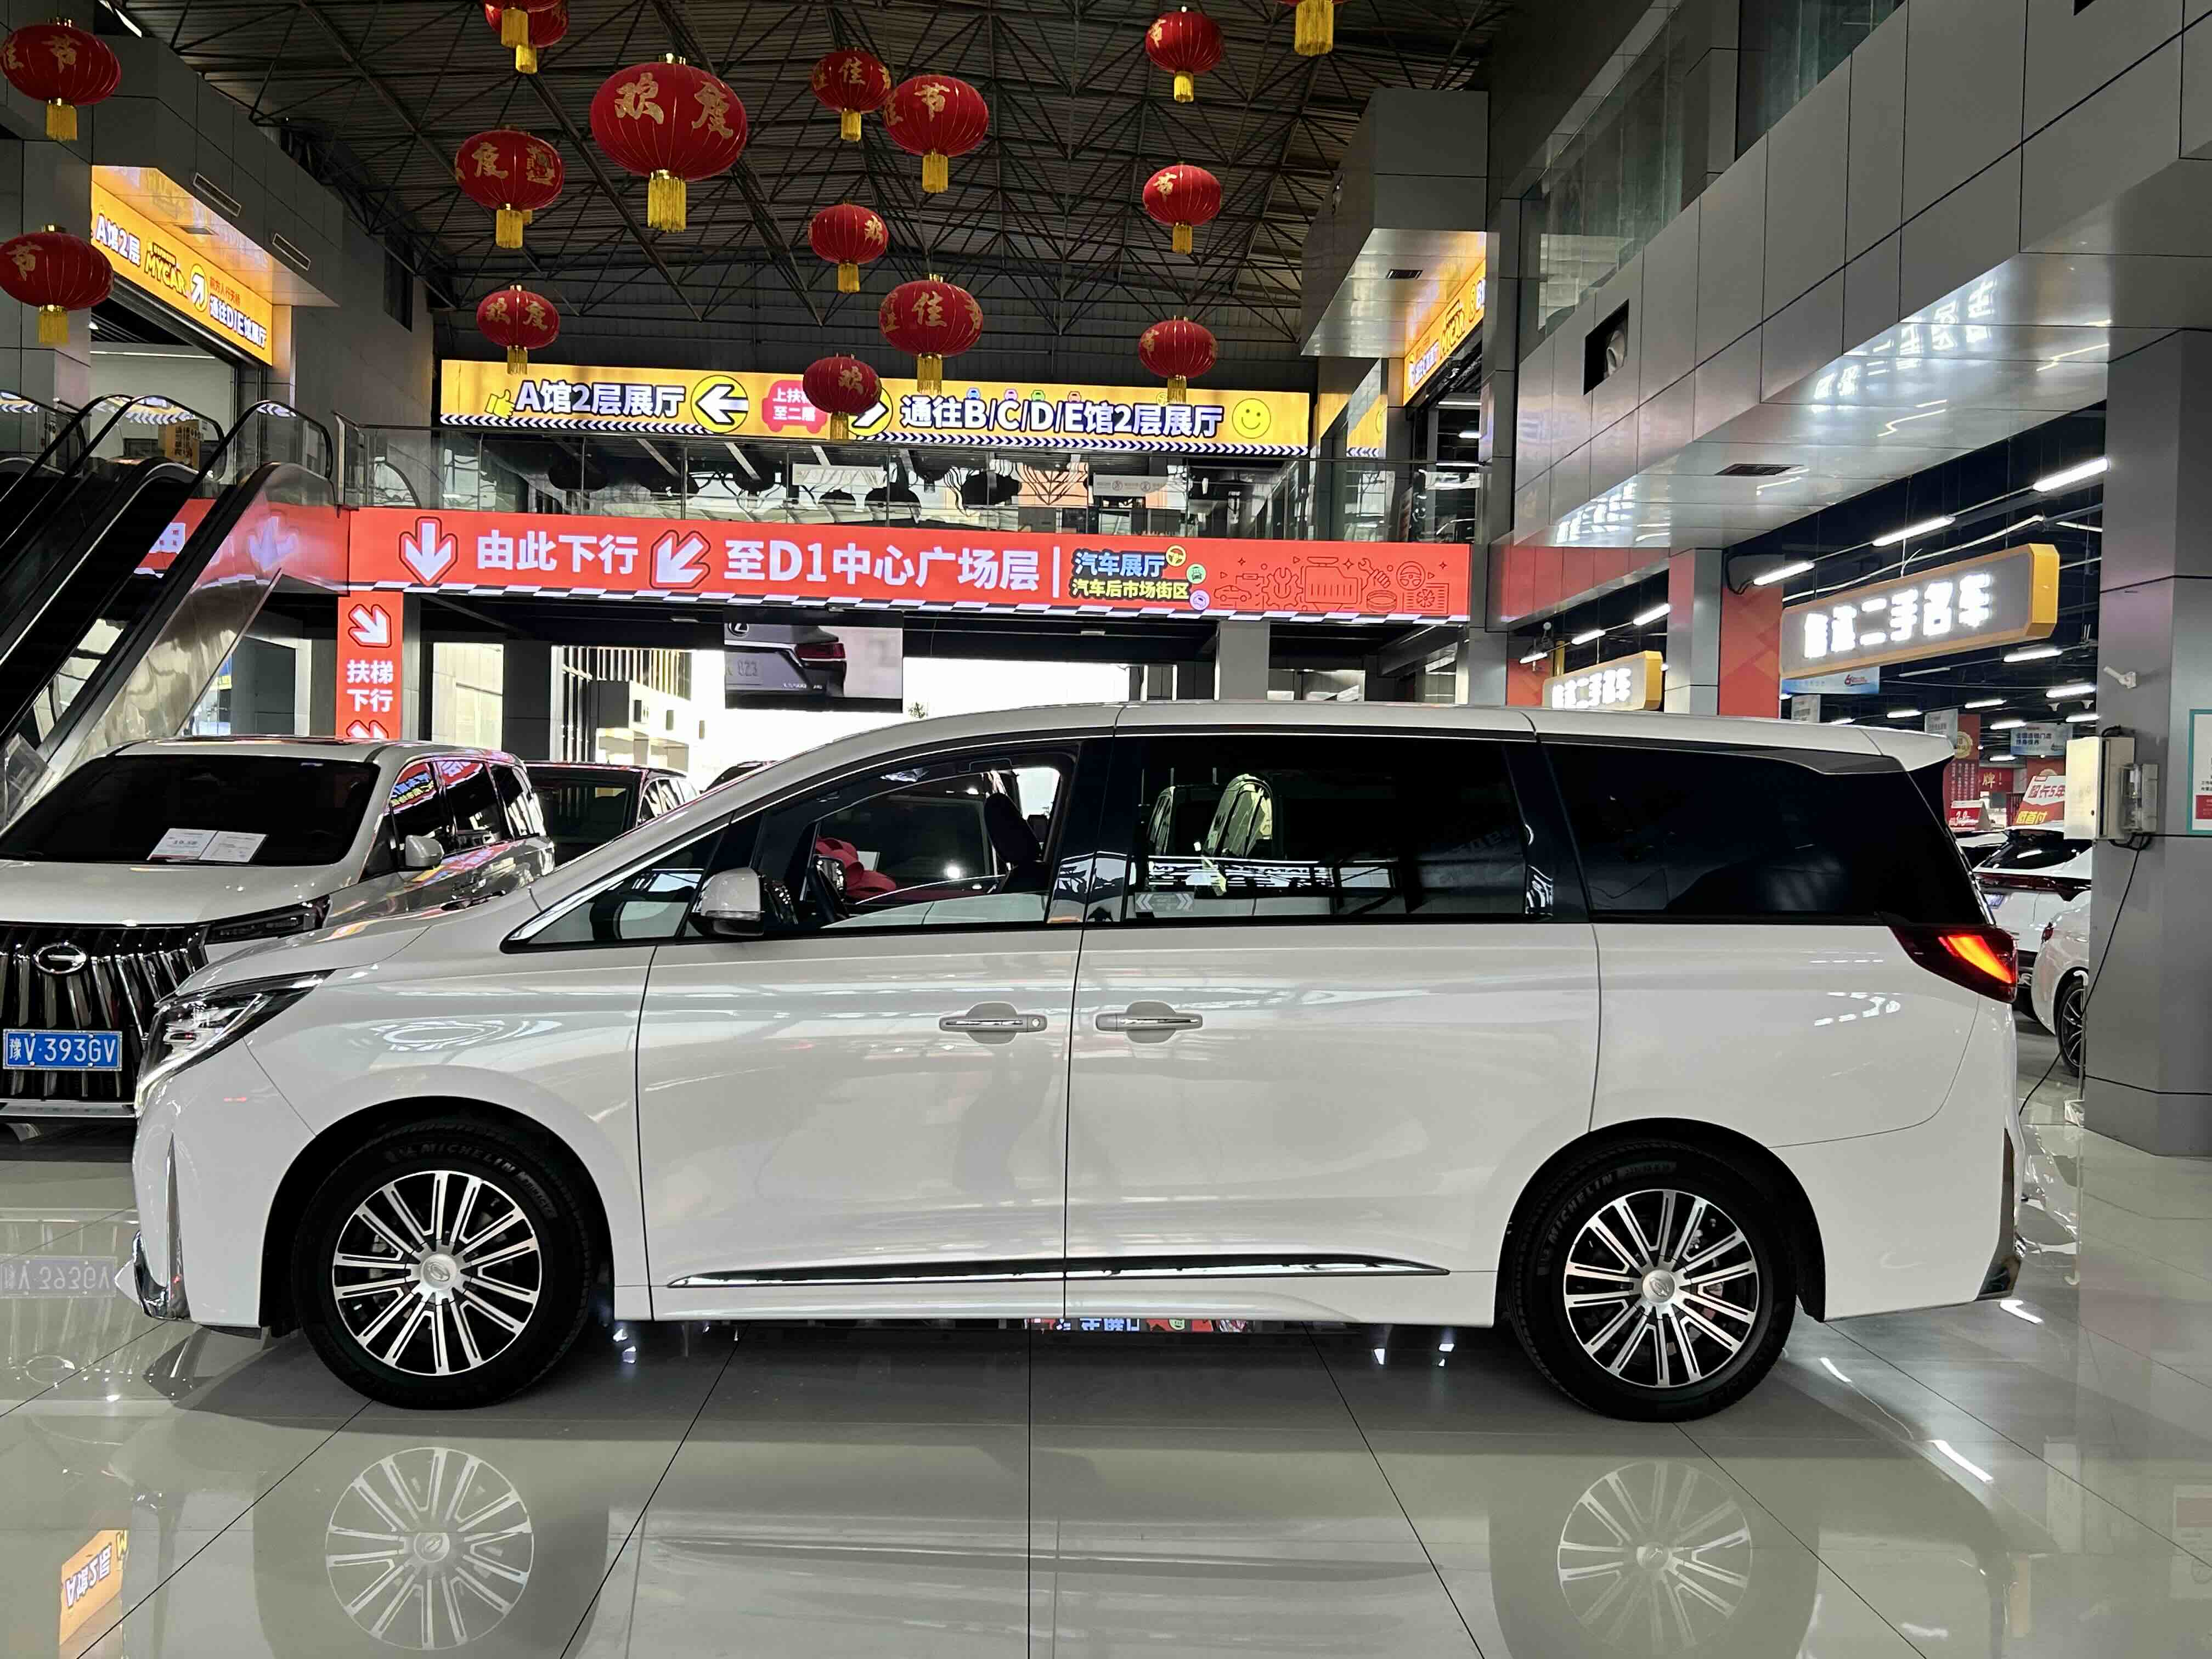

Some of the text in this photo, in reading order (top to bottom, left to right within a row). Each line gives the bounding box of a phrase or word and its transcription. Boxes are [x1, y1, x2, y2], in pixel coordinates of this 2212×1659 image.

[515, 380, 686, 418] A馆2层展厅
[901, 396, 1223, 437] 通往B/C/D/E馆2层展厅
[477, 529, 638, 575] 由此下行
[724, 539, 1040, 592] 至D1中心广场层
[1074, 550, 1165, 578] 汽车展厅
[1071, 578, 1190, 600] 汽车后市场街区
[346, 659, 394, 685] 扶梯
[346, 688, 393, 713] 下行
